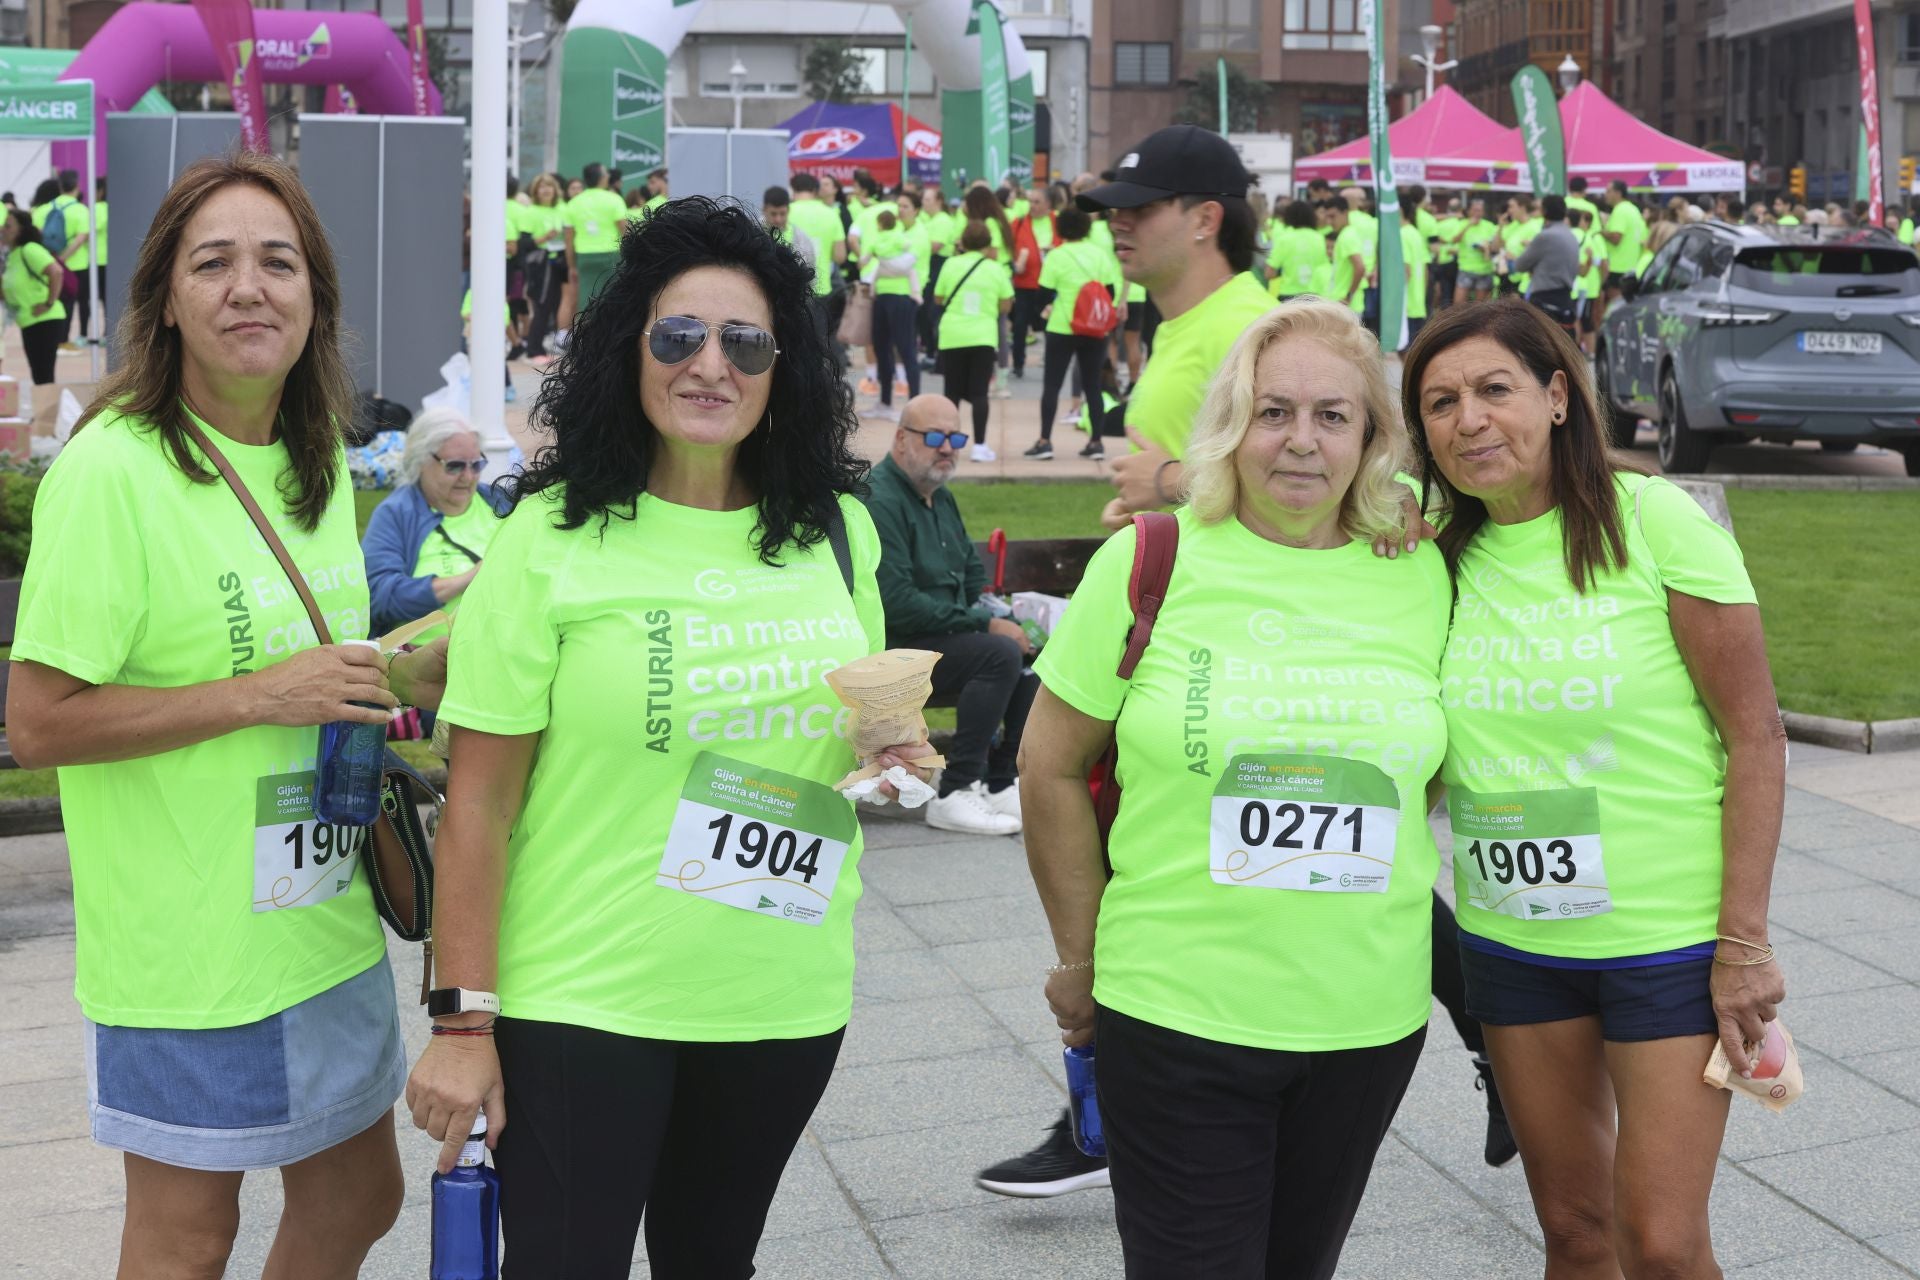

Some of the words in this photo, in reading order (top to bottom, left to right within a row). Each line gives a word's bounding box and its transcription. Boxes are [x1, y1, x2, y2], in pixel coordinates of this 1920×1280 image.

[1808, 333, 1846, 349] 0449
[1460, 593, 1490, 620] En
[218, 571, 255, 678] TURIAS
[685, 616, 734, 648] En
[1449, 633, 1564, 663] contra
[1572, 623, 1618, 661] el
[645, 609, 673, 753] ASTURIAS
[687, 654, 840, 695] contra
[1223, 656, 1273, 682] En
[1285, 664, 1426, 693] marcha
[1441, 662, 1623, 713] cáncer
[687, 696, 853, 743] cánce
[1184, 647, 1212, 778] ASTURIAS
[1222, 692, 1388, 725] contra
[1237, 773, 1273, 783] contra
[1275, 774, 1286, 784] el
[1288, 775, 1325, 786] cáncer
[1239, 762, 1266, 775] Gijón
[1269, 765, 1282, 774] en
[1284, 763, 1325, 775] marcha
[1456, 755, 1553, 778] LABORA
[277, 785, 303, 800] Gijón
[711, 780, 746, 797] contra
[749, 789, 760, 800] el
[761, 792, 797, 811] cáncer
[714, 768, 743, 784] Gijón
[745, 776, 759, 787] en
[760, 780, 798, 799] marcha
[277, 797, 310, 807] contra
[1486, 803, 1523, 813] marcha
[1240, 800, 1363, 852] 0271
[1491, 814, 1524, 824] cáncer
[708, 813, 823, 884] 1904
[1468, 839, 1577, 885] 1903
